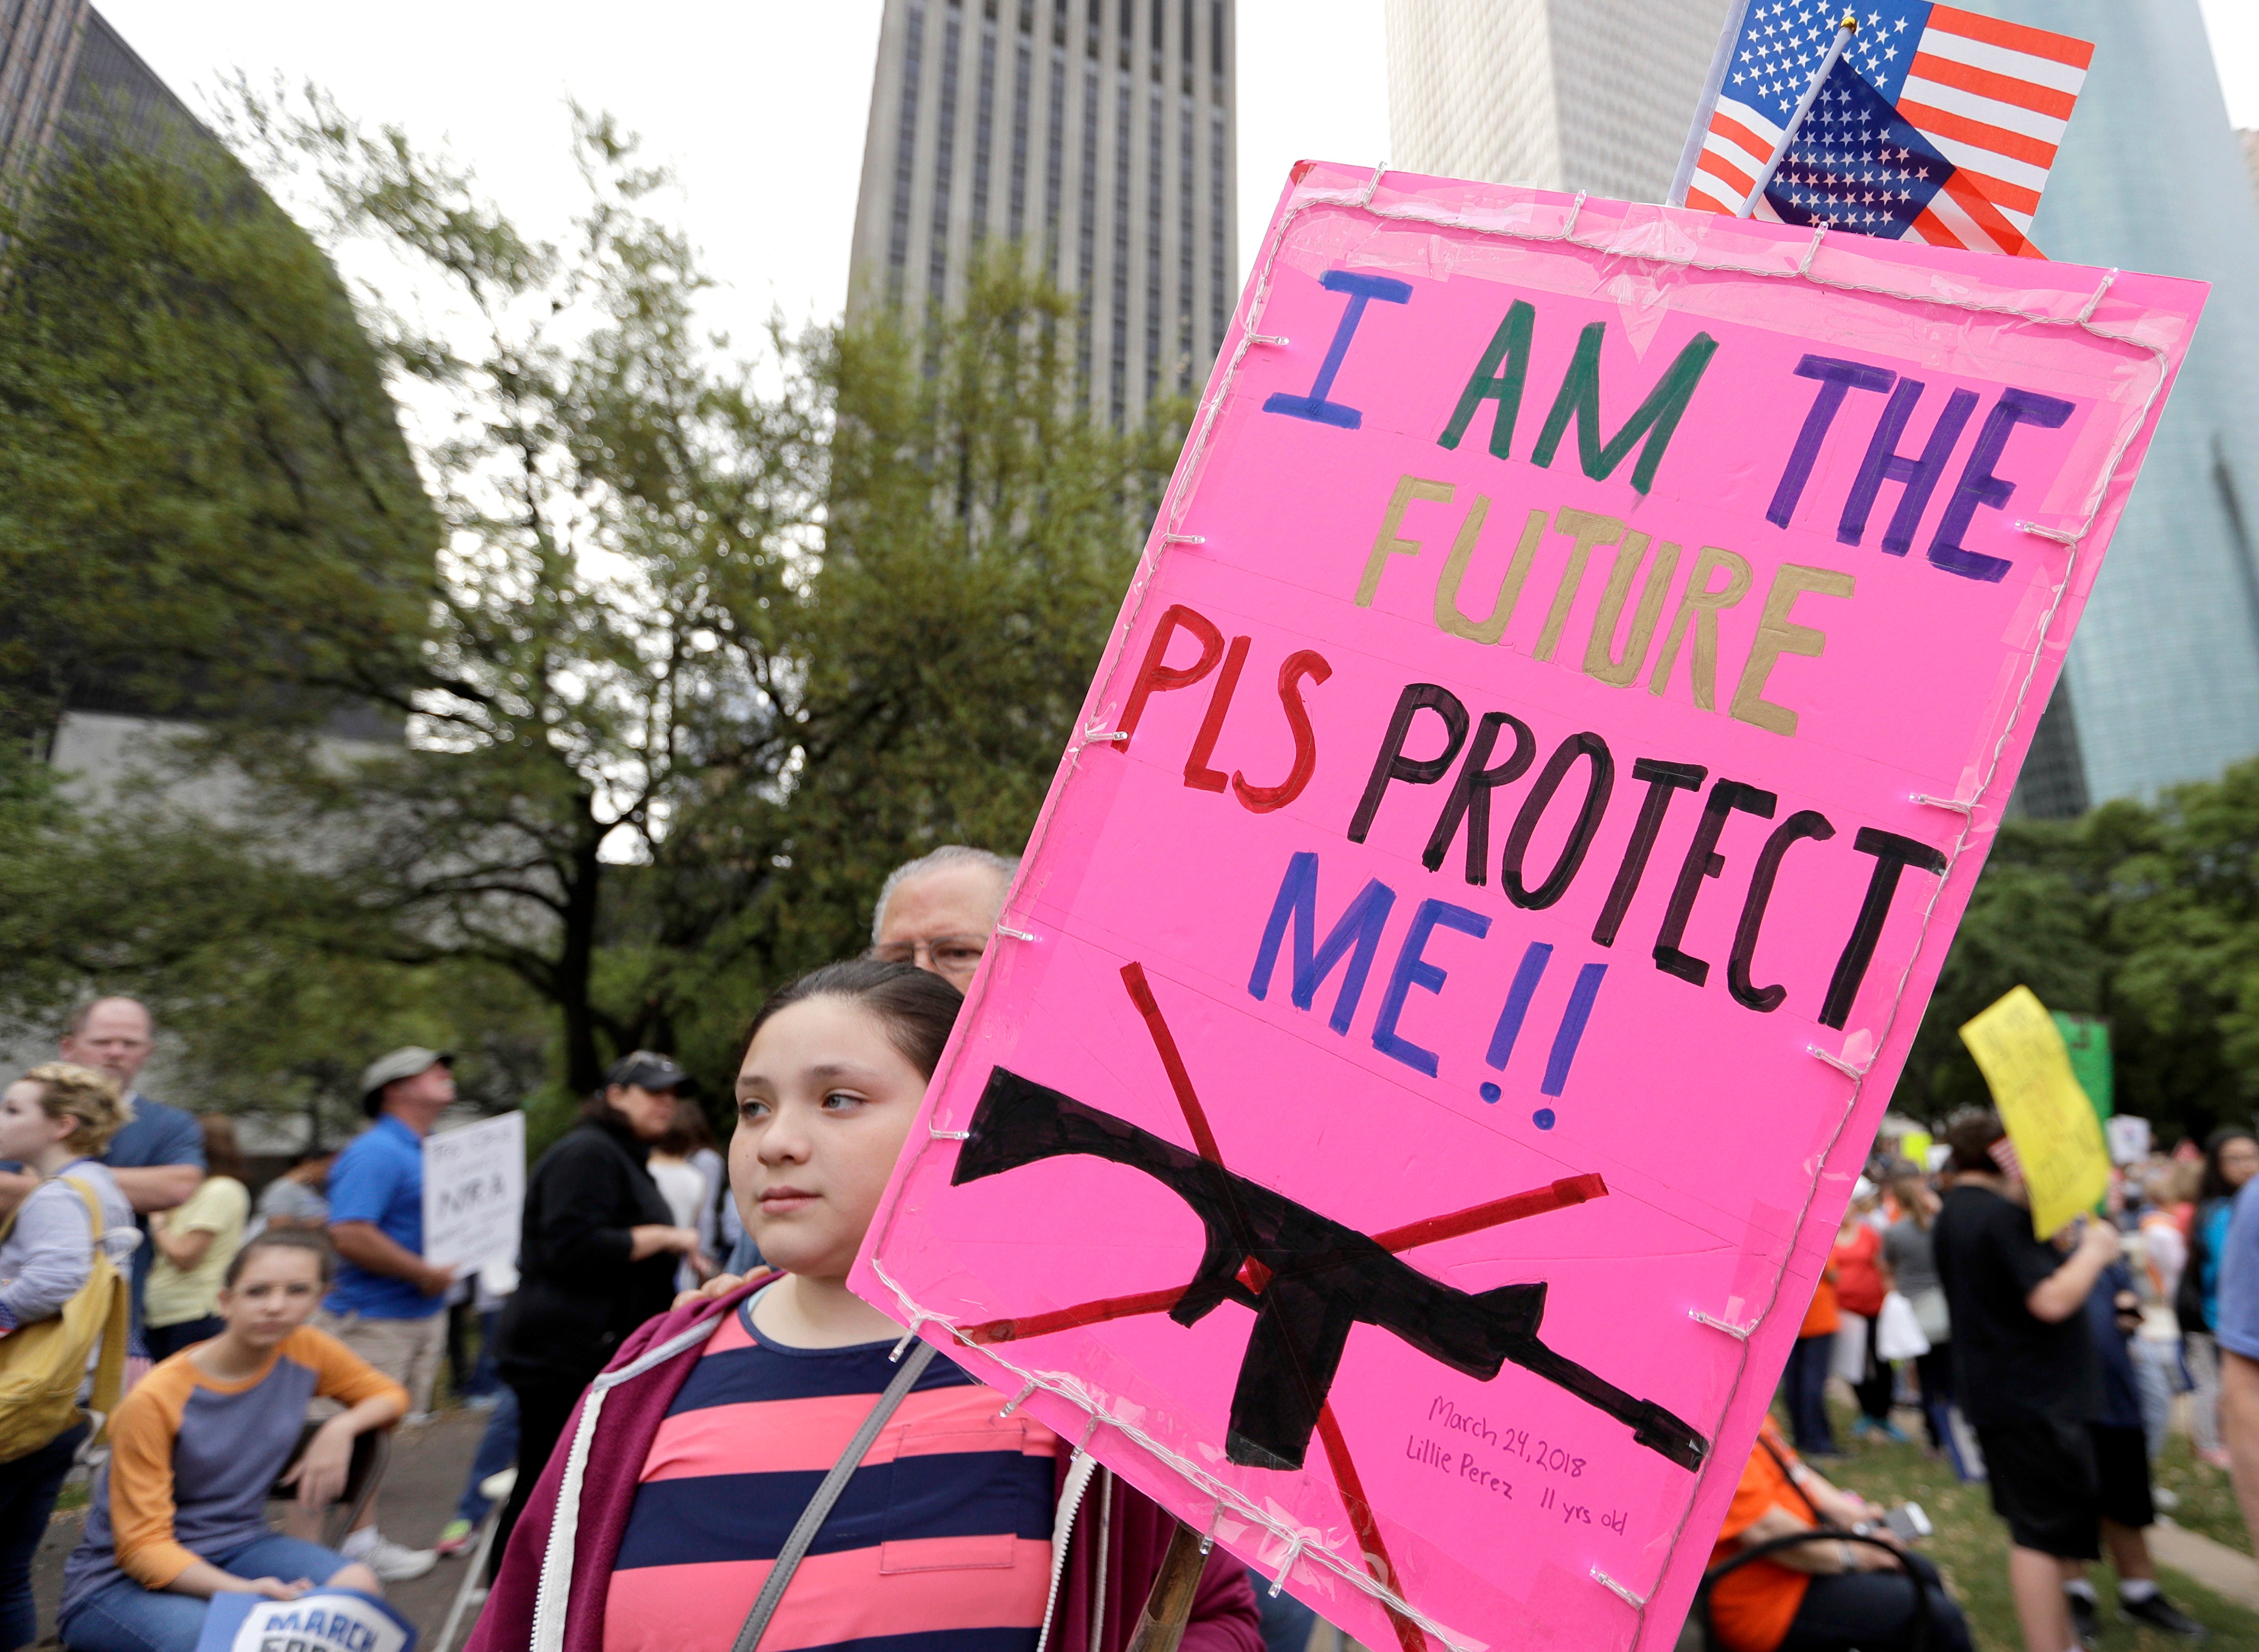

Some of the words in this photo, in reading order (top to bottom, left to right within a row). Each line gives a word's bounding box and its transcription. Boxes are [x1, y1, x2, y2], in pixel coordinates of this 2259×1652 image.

[1262, 269, 1414, 430] I
[1436, 298, 1720, 495] AM
[1765, 353, 2077, 583] THE
[1354, 474, 1856, 738] FUTURE
[1110, 604, 1333, 814] PLS
[1346, 682, 1948, 1032] PROTECT
[1247, 851, 1609, 1130] ME!!
[1406, 1434, 1452, 1473] Lillie
[1460, 1453, 1512, 1500] Perez
[1541, 1487, 1555, 1510] 11
[1563, 1503, 1592, 1524] yrs
[1601, 1509, 1628, 1536] old
[1429, 1395, 1498, 1447] March
[265, 1609, 378, 1652] MARCH
